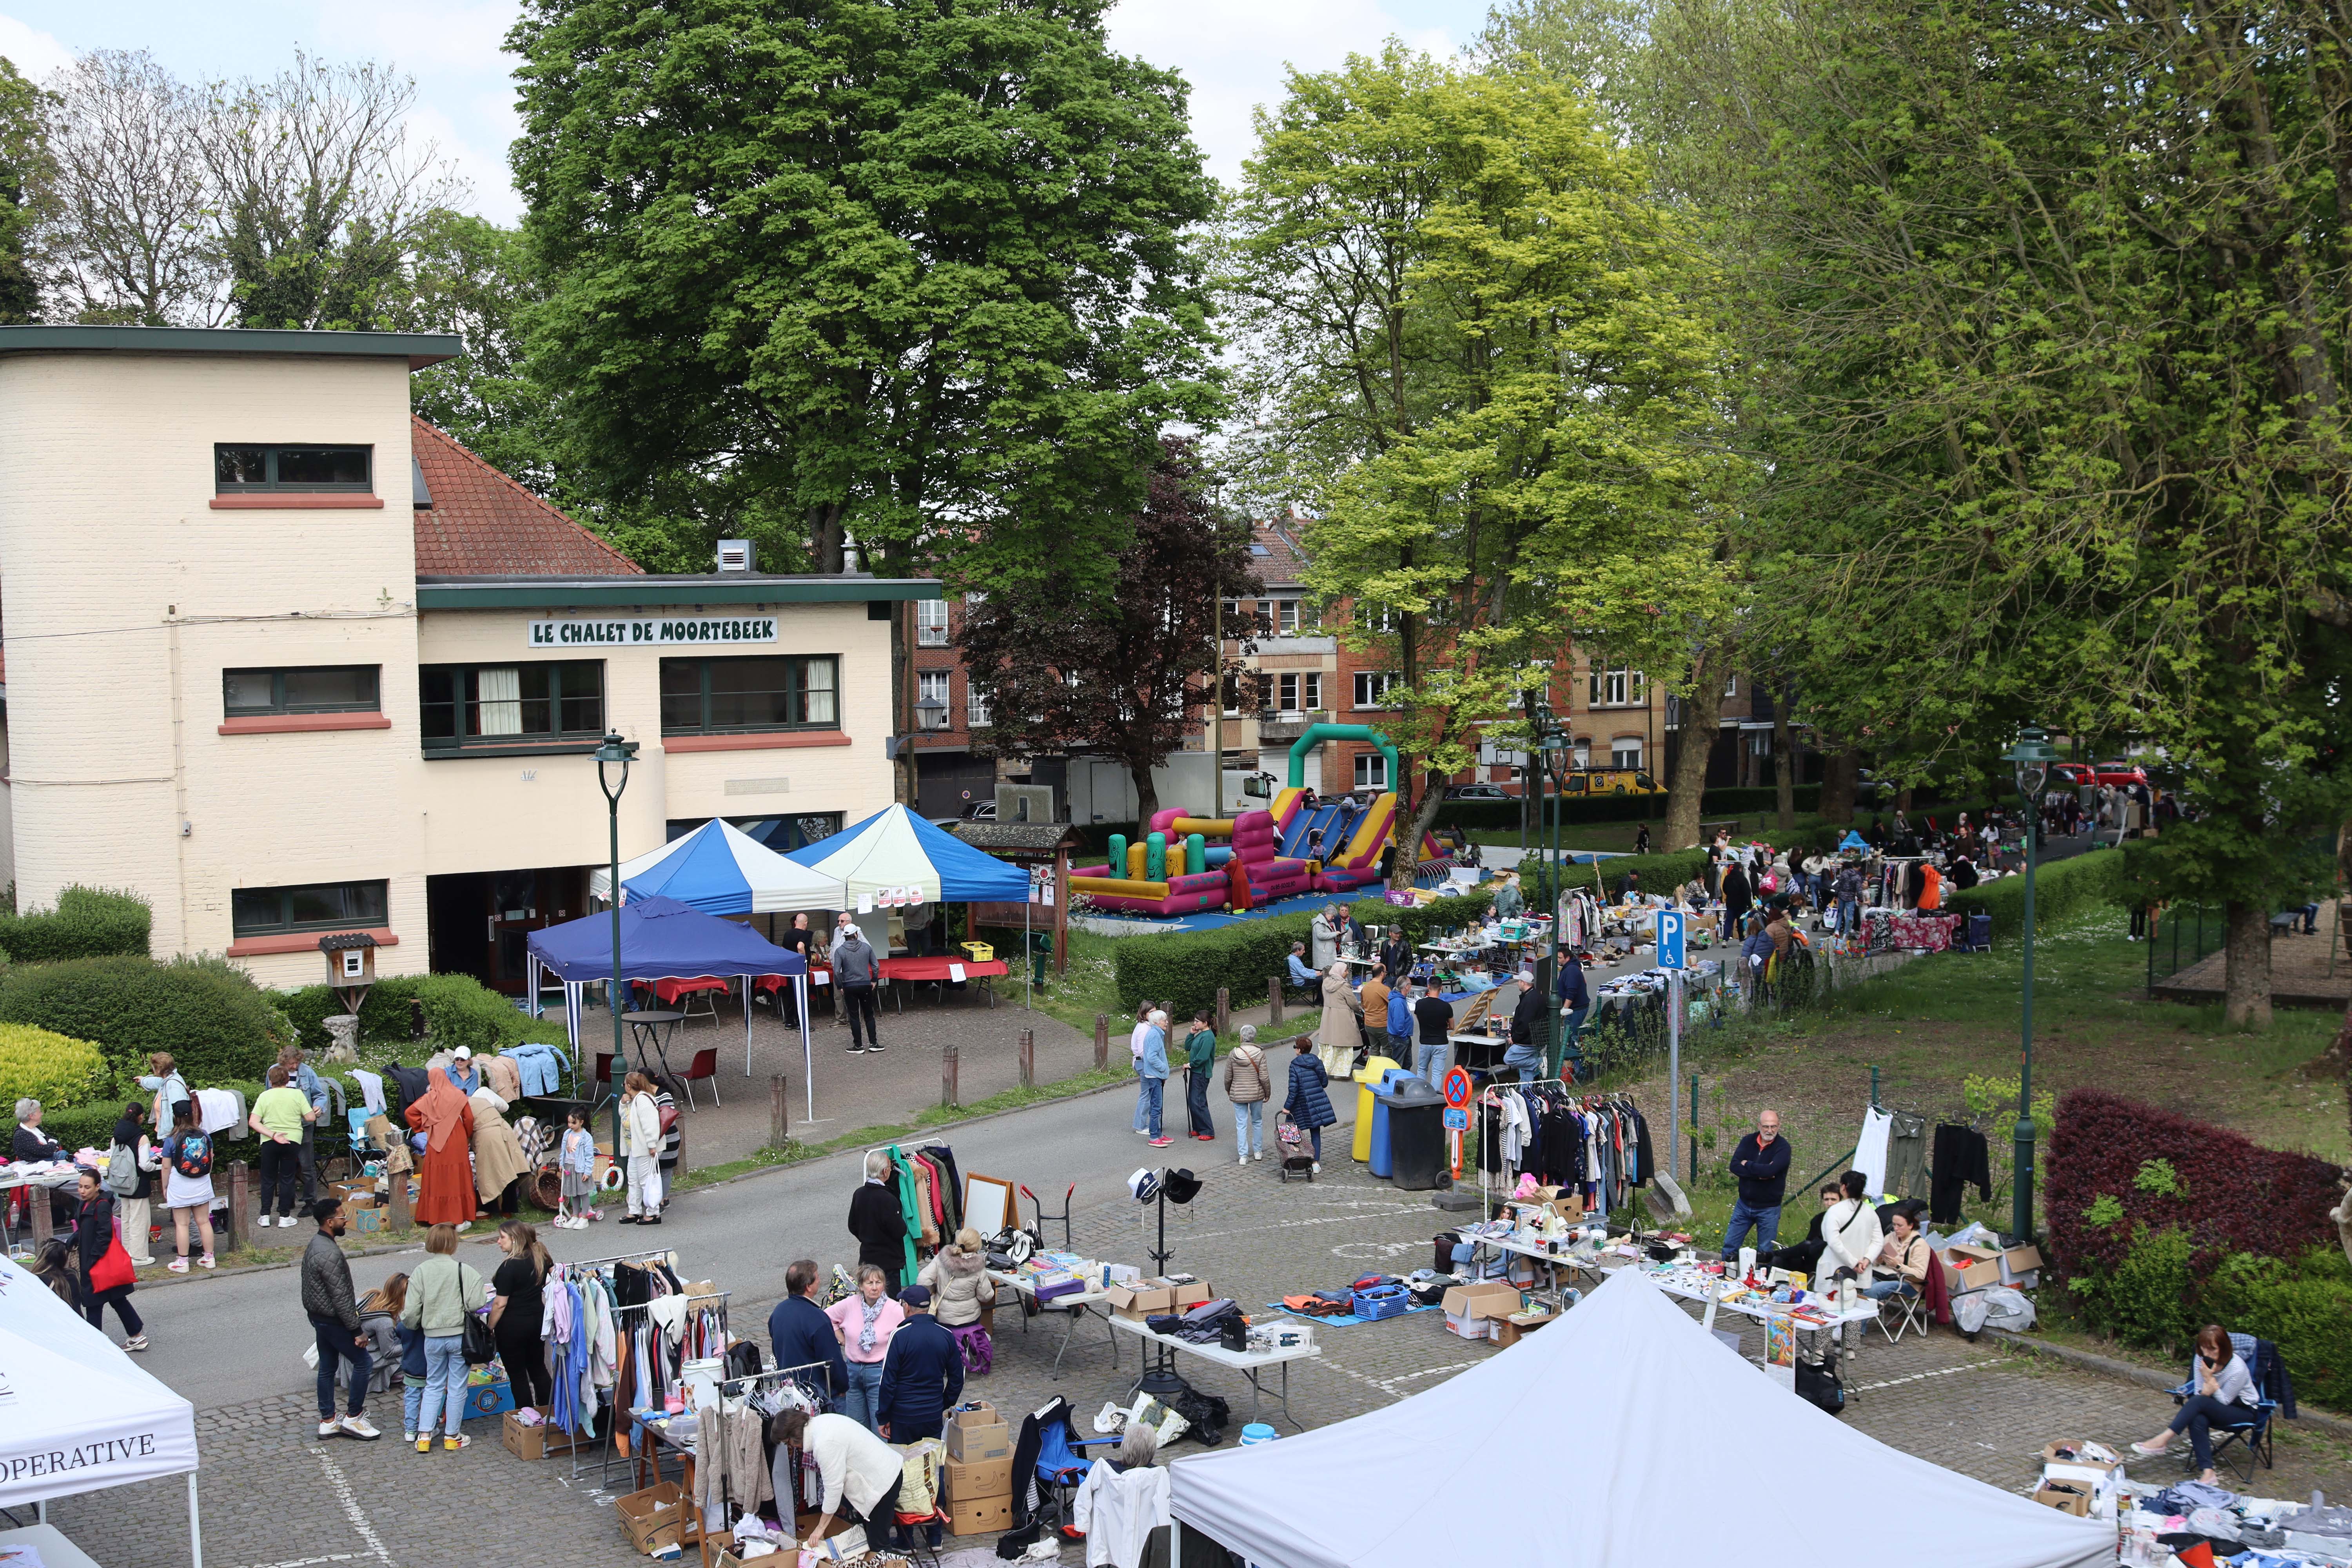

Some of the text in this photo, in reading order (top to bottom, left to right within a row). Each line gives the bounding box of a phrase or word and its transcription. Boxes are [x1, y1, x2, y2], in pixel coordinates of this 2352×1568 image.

[534, 620, 773, 643] LE CHALET DE MOORTEBEEK
[1663, 915, 1678, 945] P
